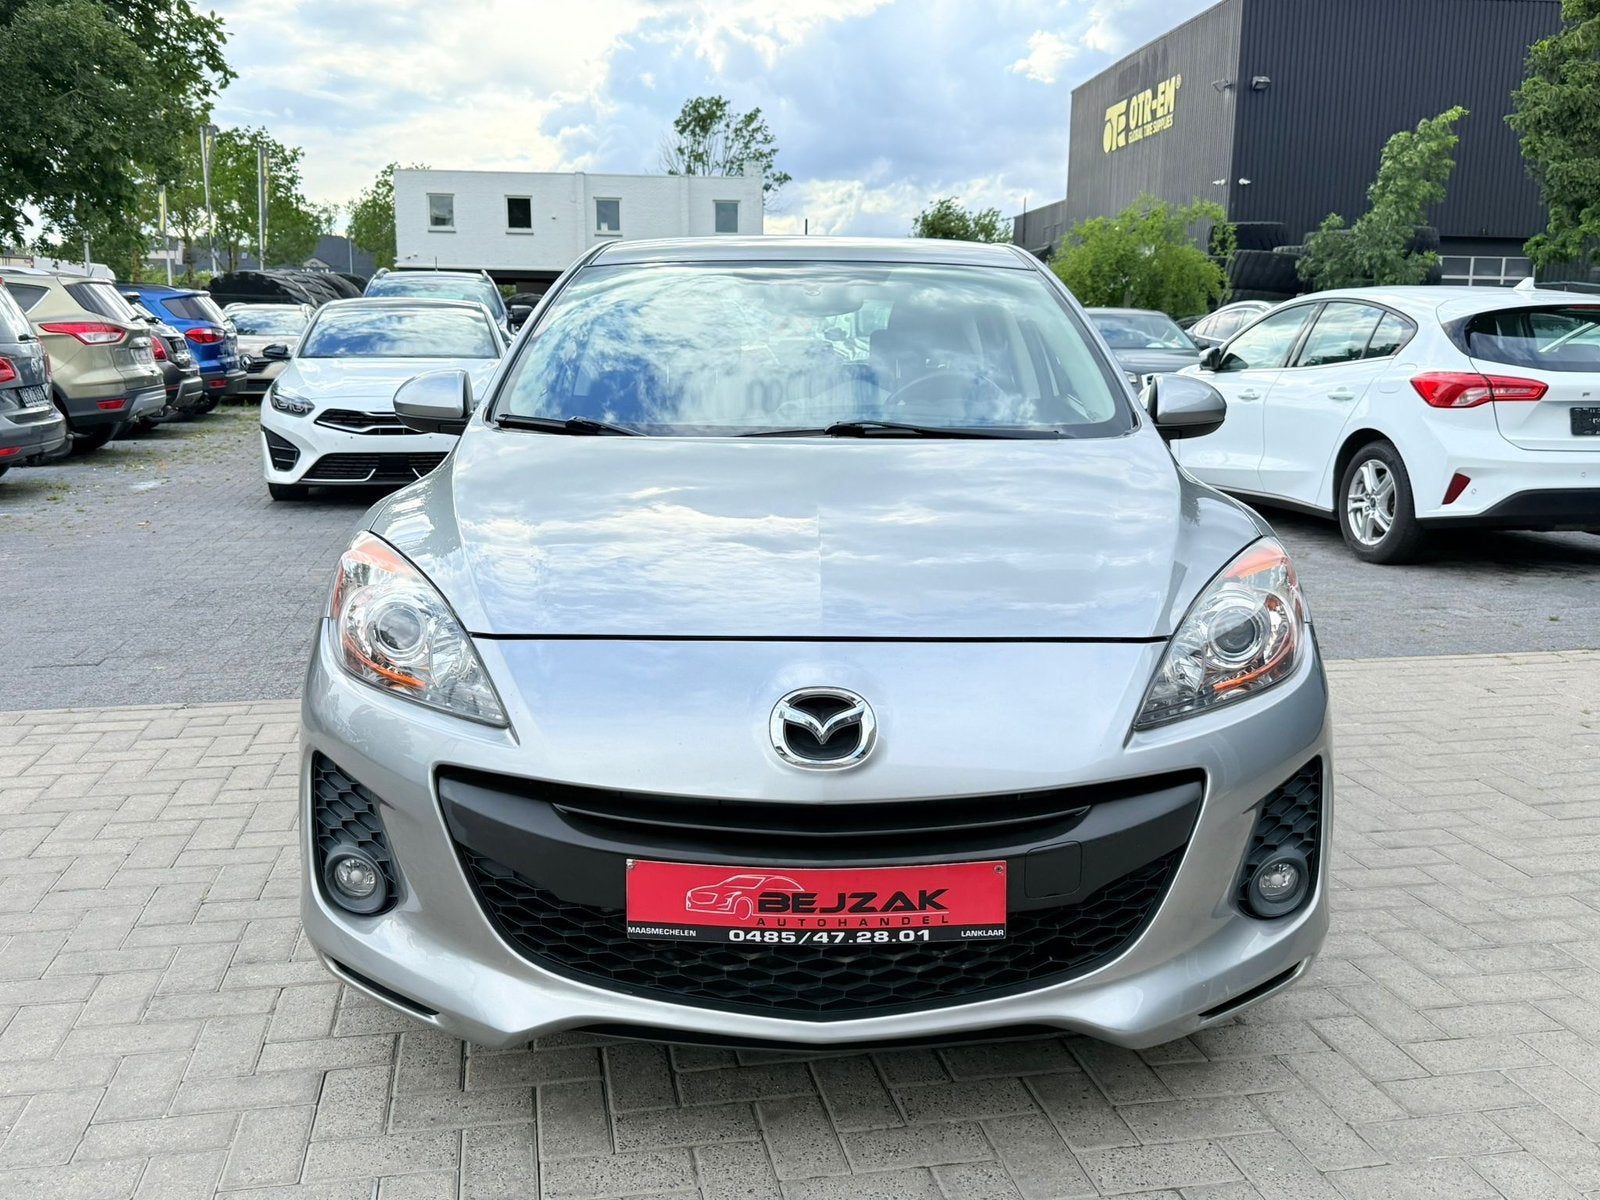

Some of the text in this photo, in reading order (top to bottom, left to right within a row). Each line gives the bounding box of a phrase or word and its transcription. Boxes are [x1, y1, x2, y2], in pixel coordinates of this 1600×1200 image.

[758, 888, 950, 914] BEJZAK
[756, 915, 949, 928] AUTOHANDEL
[627, 926, 697, 937] MAASMECHELEN
[728, 929, 930, 945] 0485/47.28.01
[960, 929, 1005, 938] LANKLAAR
